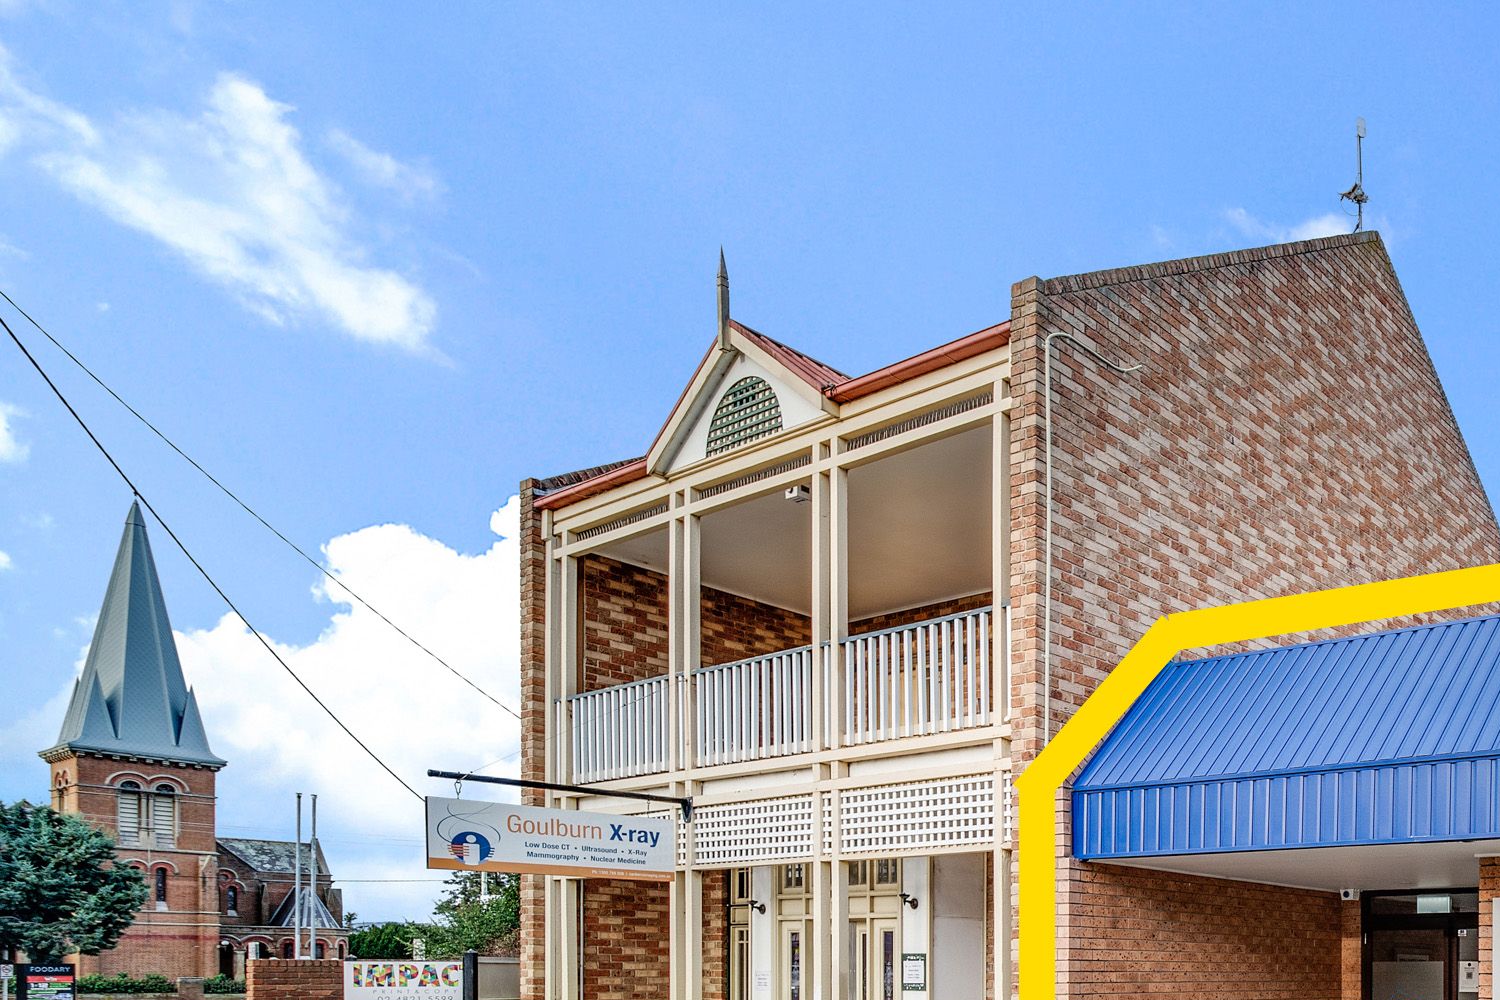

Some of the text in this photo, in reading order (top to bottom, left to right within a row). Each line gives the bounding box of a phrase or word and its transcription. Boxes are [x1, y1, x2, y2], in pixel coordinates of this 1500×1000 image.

[506, 814, 661, 848] Goulburn X-ray
[524, 841, 541, 849] Low
[542, 842, 560, 850] Dose
[581, 845, 648, 857] Ultrasound X-Ray
[526, 851, 580, 861] Mammography
[617, 857, 647, 865] Medicine
[353, 964, 463, 987] IMPAC
